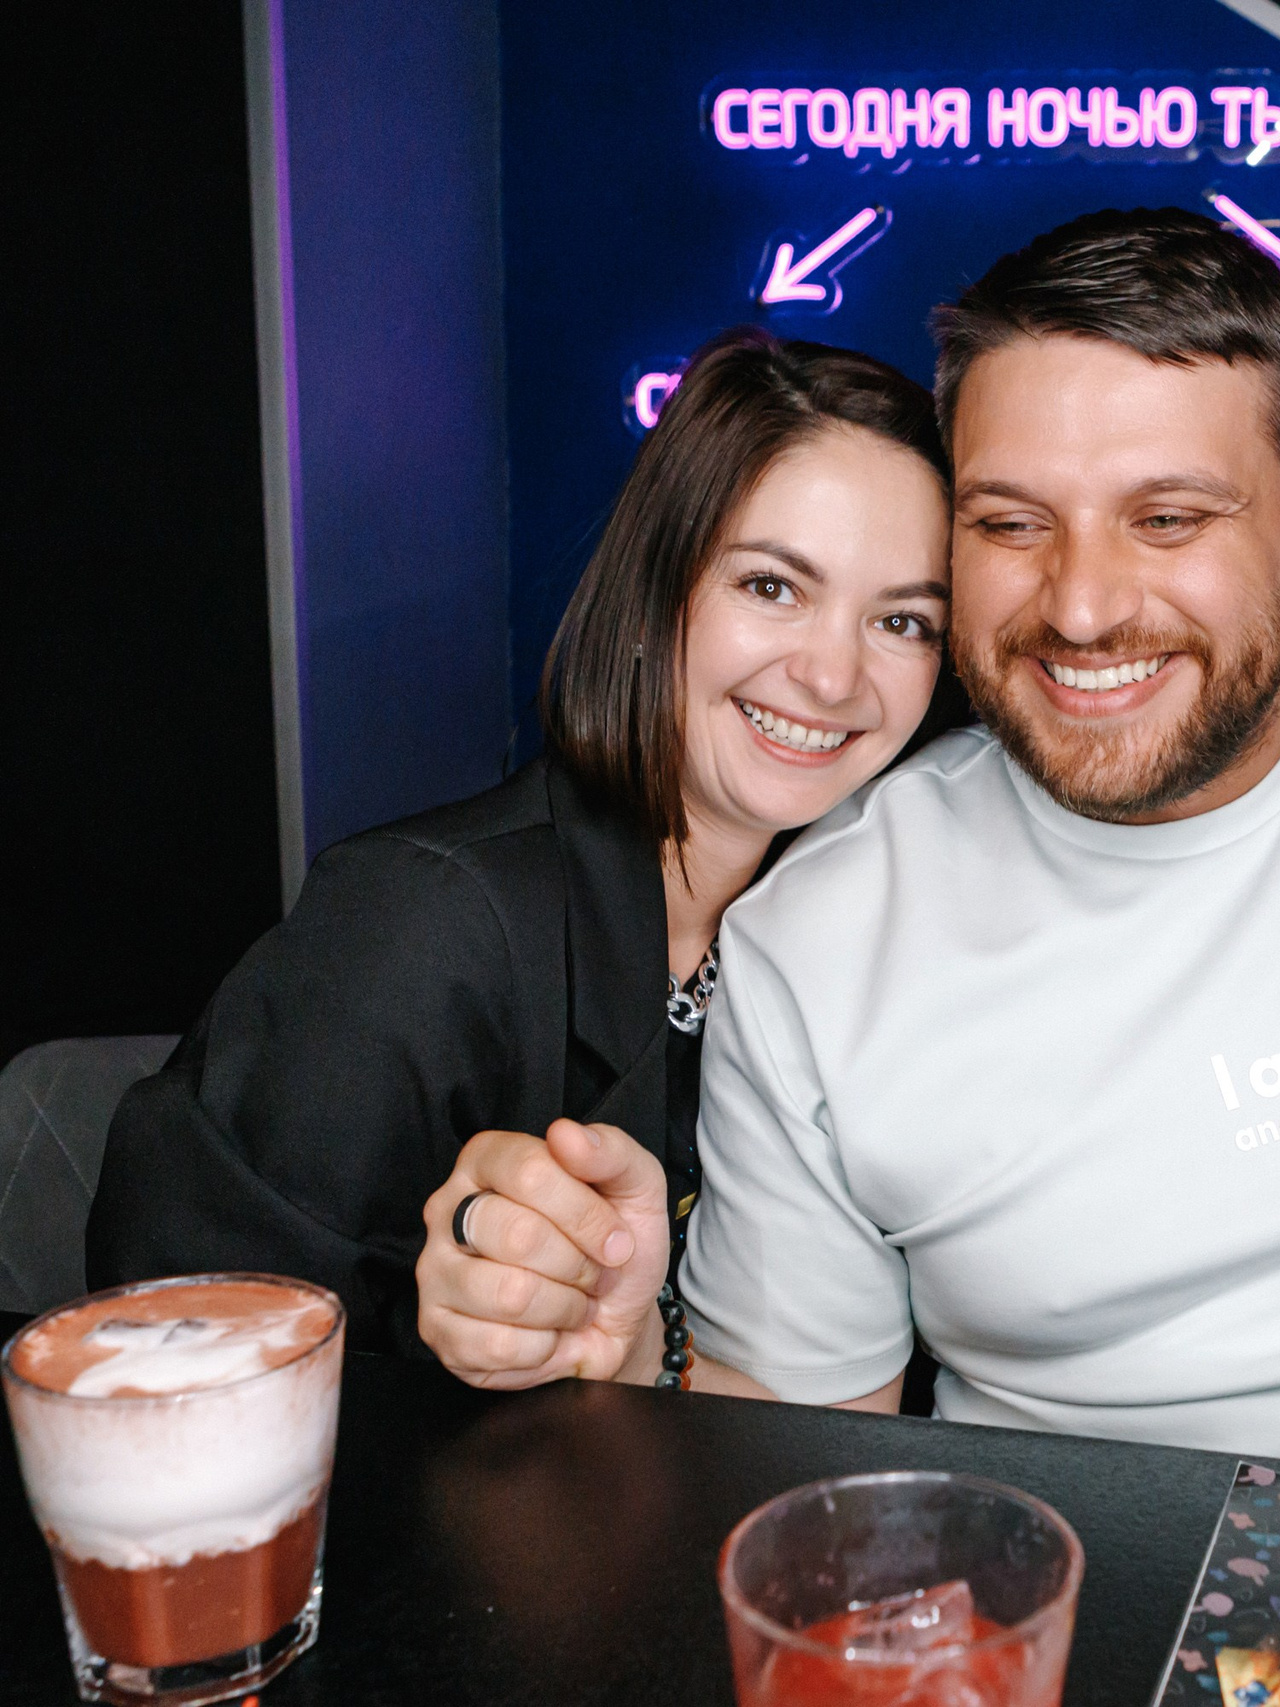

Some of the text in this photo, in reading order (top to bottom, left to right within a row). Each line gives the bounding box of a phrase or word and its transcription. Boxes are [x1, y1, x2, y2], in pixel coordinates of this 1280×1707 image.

[713, 87, 971, 159] СЕГОДНЯ
[988, 87, 1197, 148] НОЧЬЮ
[1210, 1053, 1240, 1111] I
